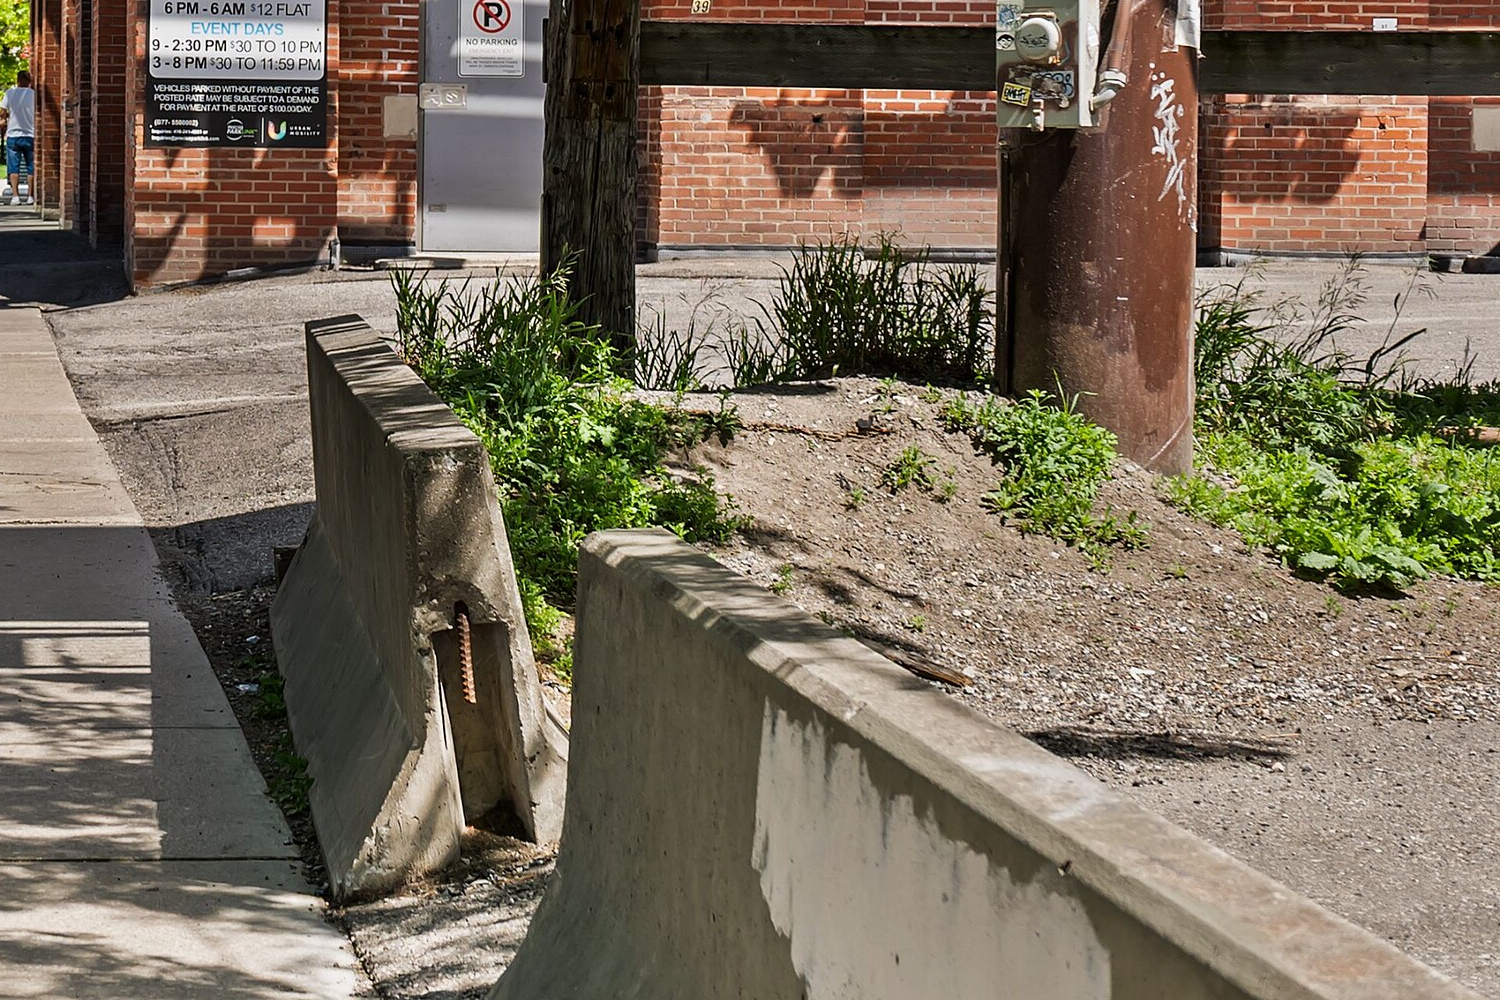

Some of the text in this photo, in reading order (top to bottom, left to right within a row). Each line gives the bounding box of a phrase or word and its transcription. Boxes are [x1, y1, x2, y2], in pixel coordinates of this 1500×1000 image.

[165, 2, 173, 14] 6
[176, 2, 199, 14] PM
[210, 3, 219, 15] 6
[221, 3, 245, 15] AM
[251, 3, 273, 16] $12
[276, 4, 311, 16] FLAT
[693, 0, 709, 13] 39
[191, 22, 284, 36] EVENT DAYS
[152, 39, 160, 51] 9
[172, 39, 200, 51] 2:30
[205, 40, 227, 51] PM
[230, 40, 252, 53] $30
[256, 41, 276, 53] TO
[281, 41, 296, 53] 10
[299, 41, 322, 53] PM
[153, 56, 161, 68] 3
[173, 57, 181, 68] 8
[185, 57, 207, 69] PM
[210, 57, 232, 70] $30
[235, 57, 256, 70] TO
[261, 58, 295, 70] 11:59
[298, 58, 321, 70] PM
[154, 84, 319, 94] VEHICLES PARKED WITHOUT PAYMENT OF THE
[154, 94, 184, 102] POSTED
[186, 94, 205, 102] RATE
[206, 95, 222, 103] MAY
[223, 95, 232, 103] BE
[233, 95, 267, 103] SUBJECT
[286, 96, 319, 104] DEMAND
[160, 104, 175, 112] FOR
[176, 104, 211, 112] PAYMENT
[212, 104, 221, 112] AT
[257, 105, 268, 113] OF
